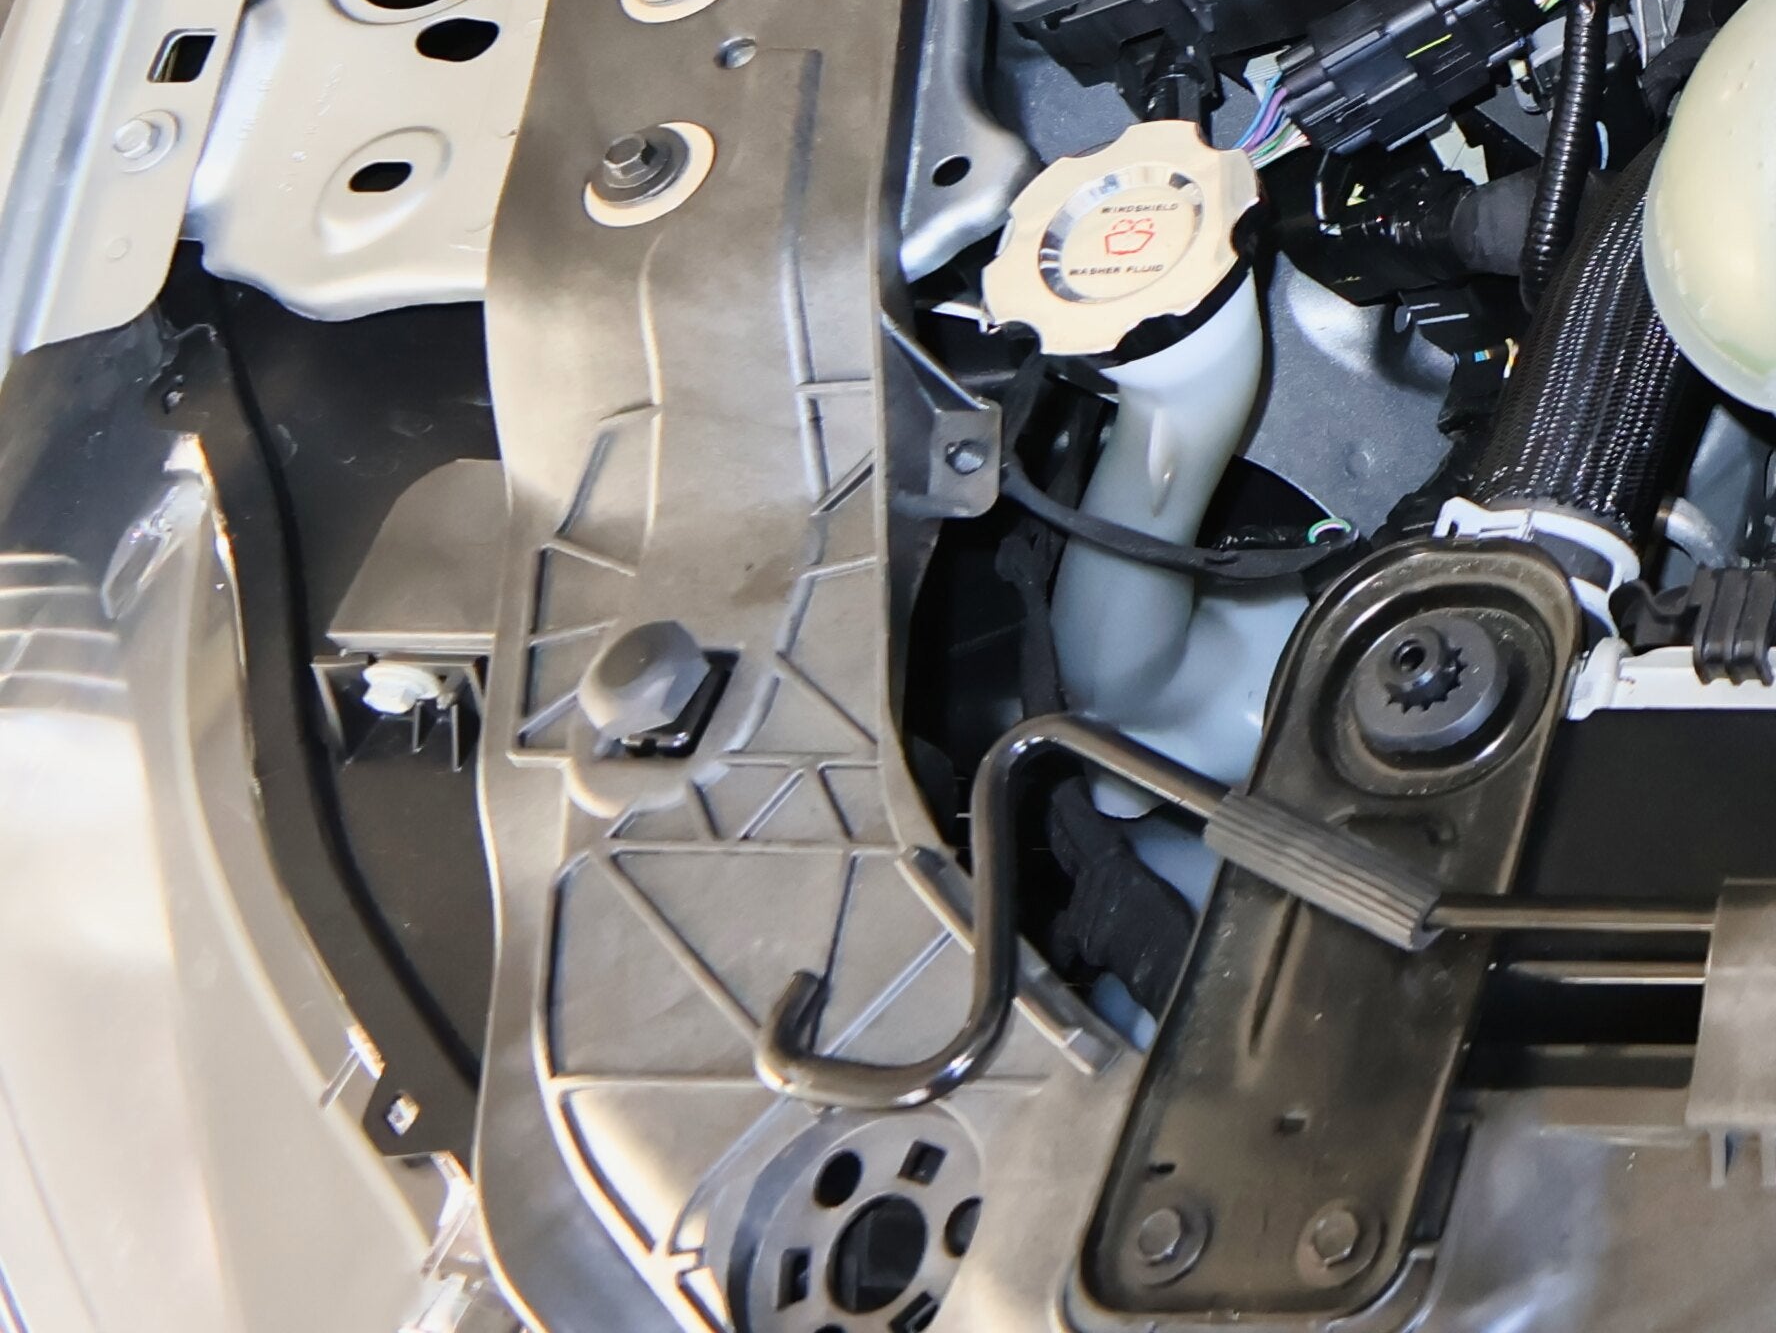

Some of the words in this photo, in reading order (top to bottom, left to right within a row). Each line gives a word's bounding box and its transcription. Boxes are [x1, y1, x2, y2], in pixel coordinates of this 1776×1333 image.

[1101, 203, 1179, 214] WINDSHIELD
[1069, 265, 1121, 276] WASHER
[1126, 264, 1165, 273] FLUID
